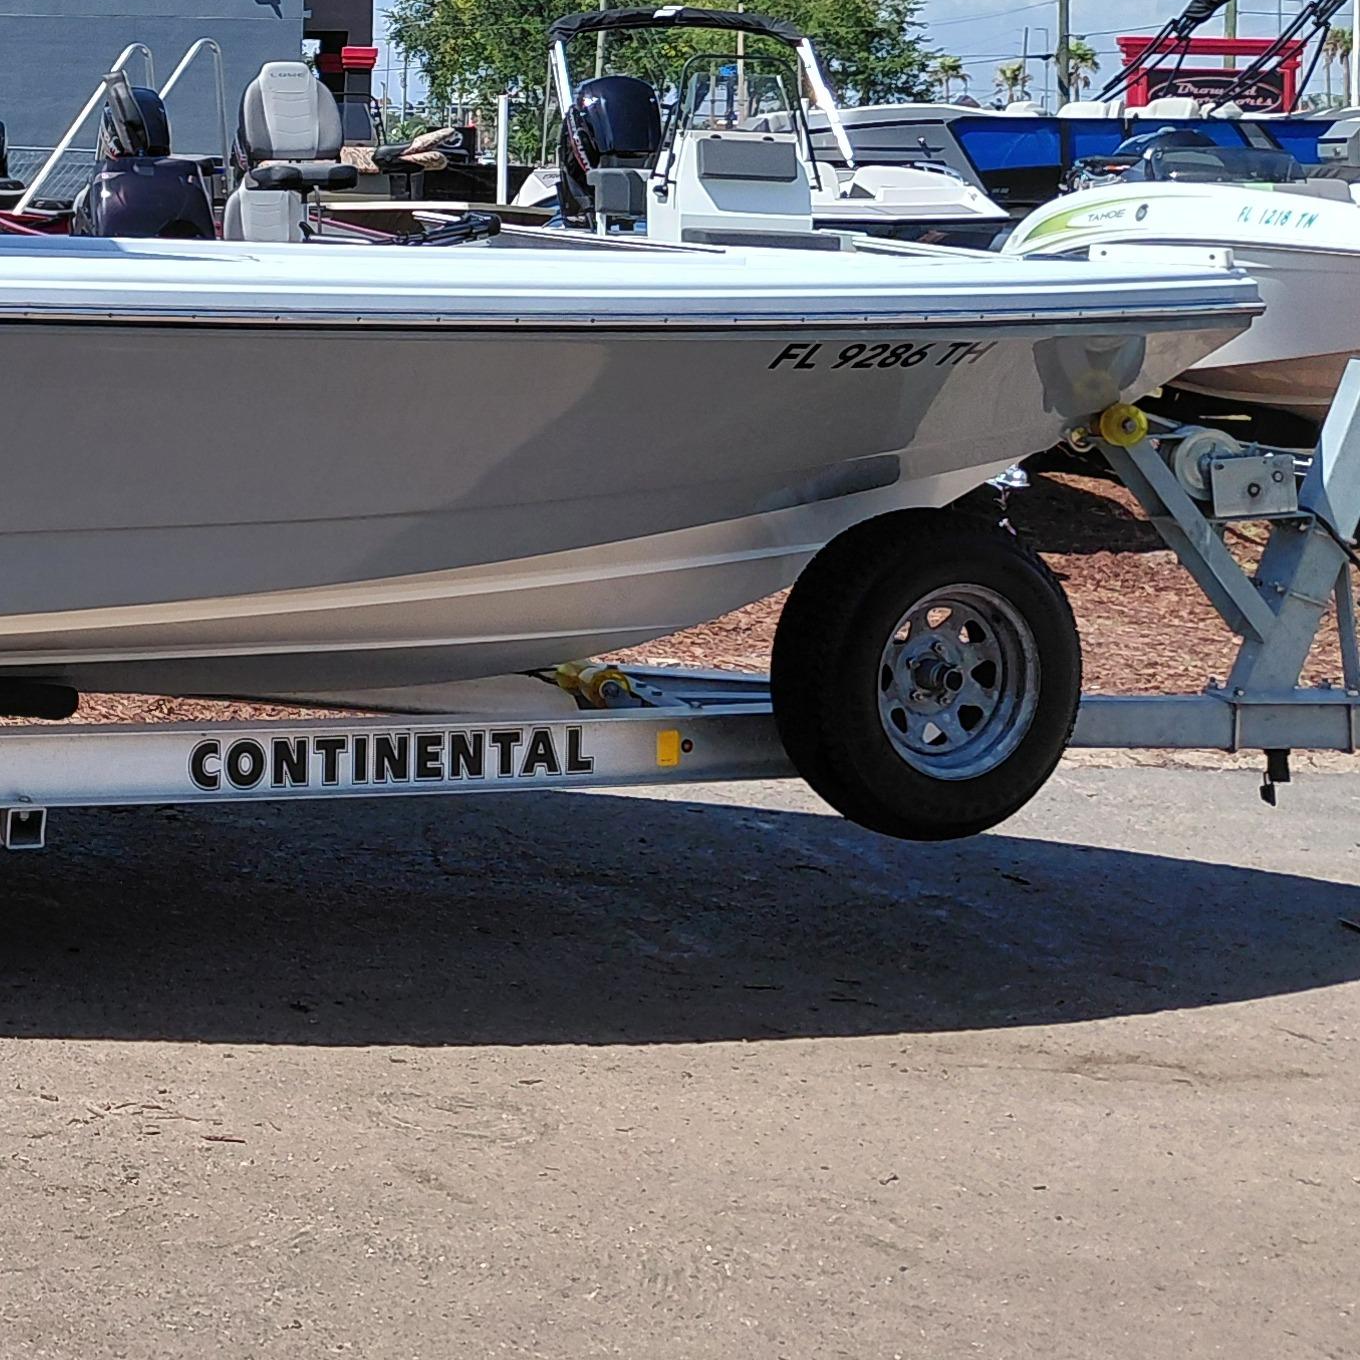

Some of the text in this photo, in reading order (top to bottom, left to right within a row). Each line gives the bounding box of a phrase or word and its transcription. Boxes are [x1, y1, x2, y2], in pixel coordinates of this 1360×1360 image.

[1088, 208, 1127, 223] TAHOE
[768, 340, 999, 370] FL 9286 TH
[188, 726, 595, 792] CONTINENTAL
